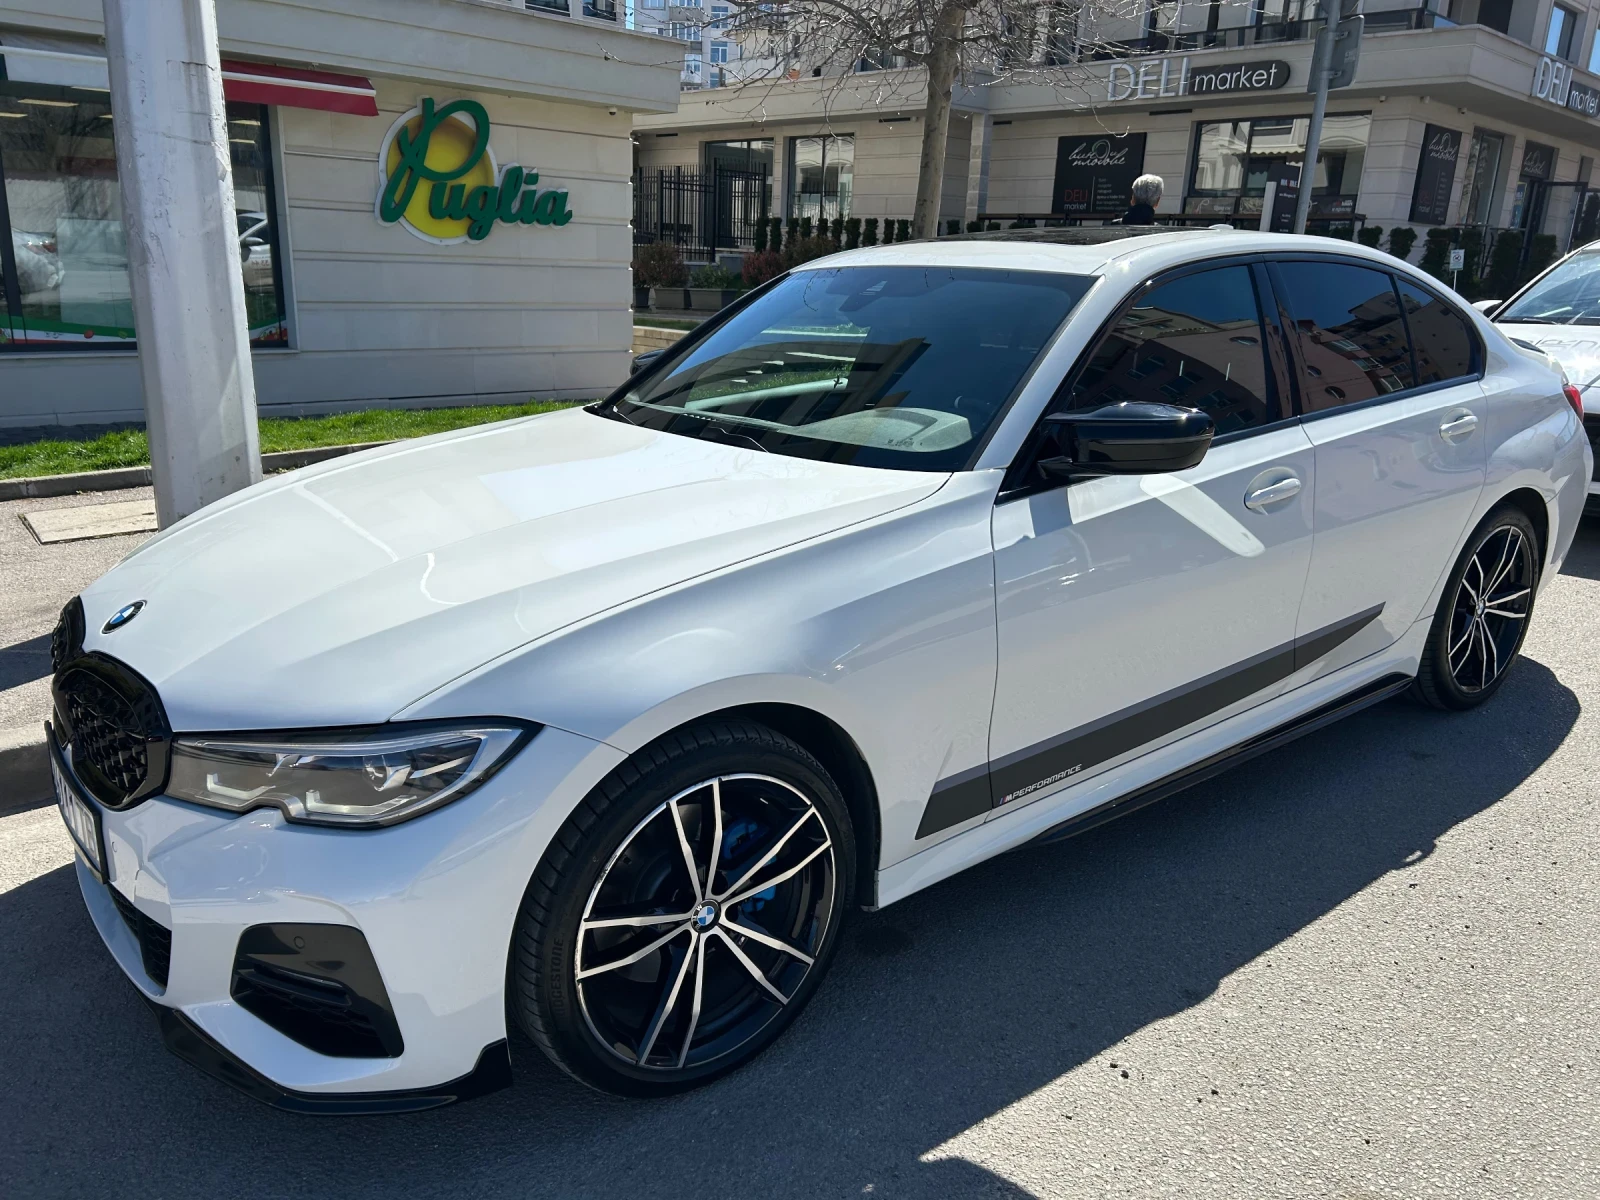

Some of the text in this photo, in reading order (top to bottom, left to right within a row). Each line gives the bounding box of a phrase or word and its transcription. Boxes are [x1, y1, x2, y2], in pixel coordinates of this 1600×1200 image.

[1107, 57, 1278, 101] DELI market
[1534, 56, 1573, 107] DELI
[380, 97, 573, 240] Puglia
[1064, 189, 1088, 202] DELI
